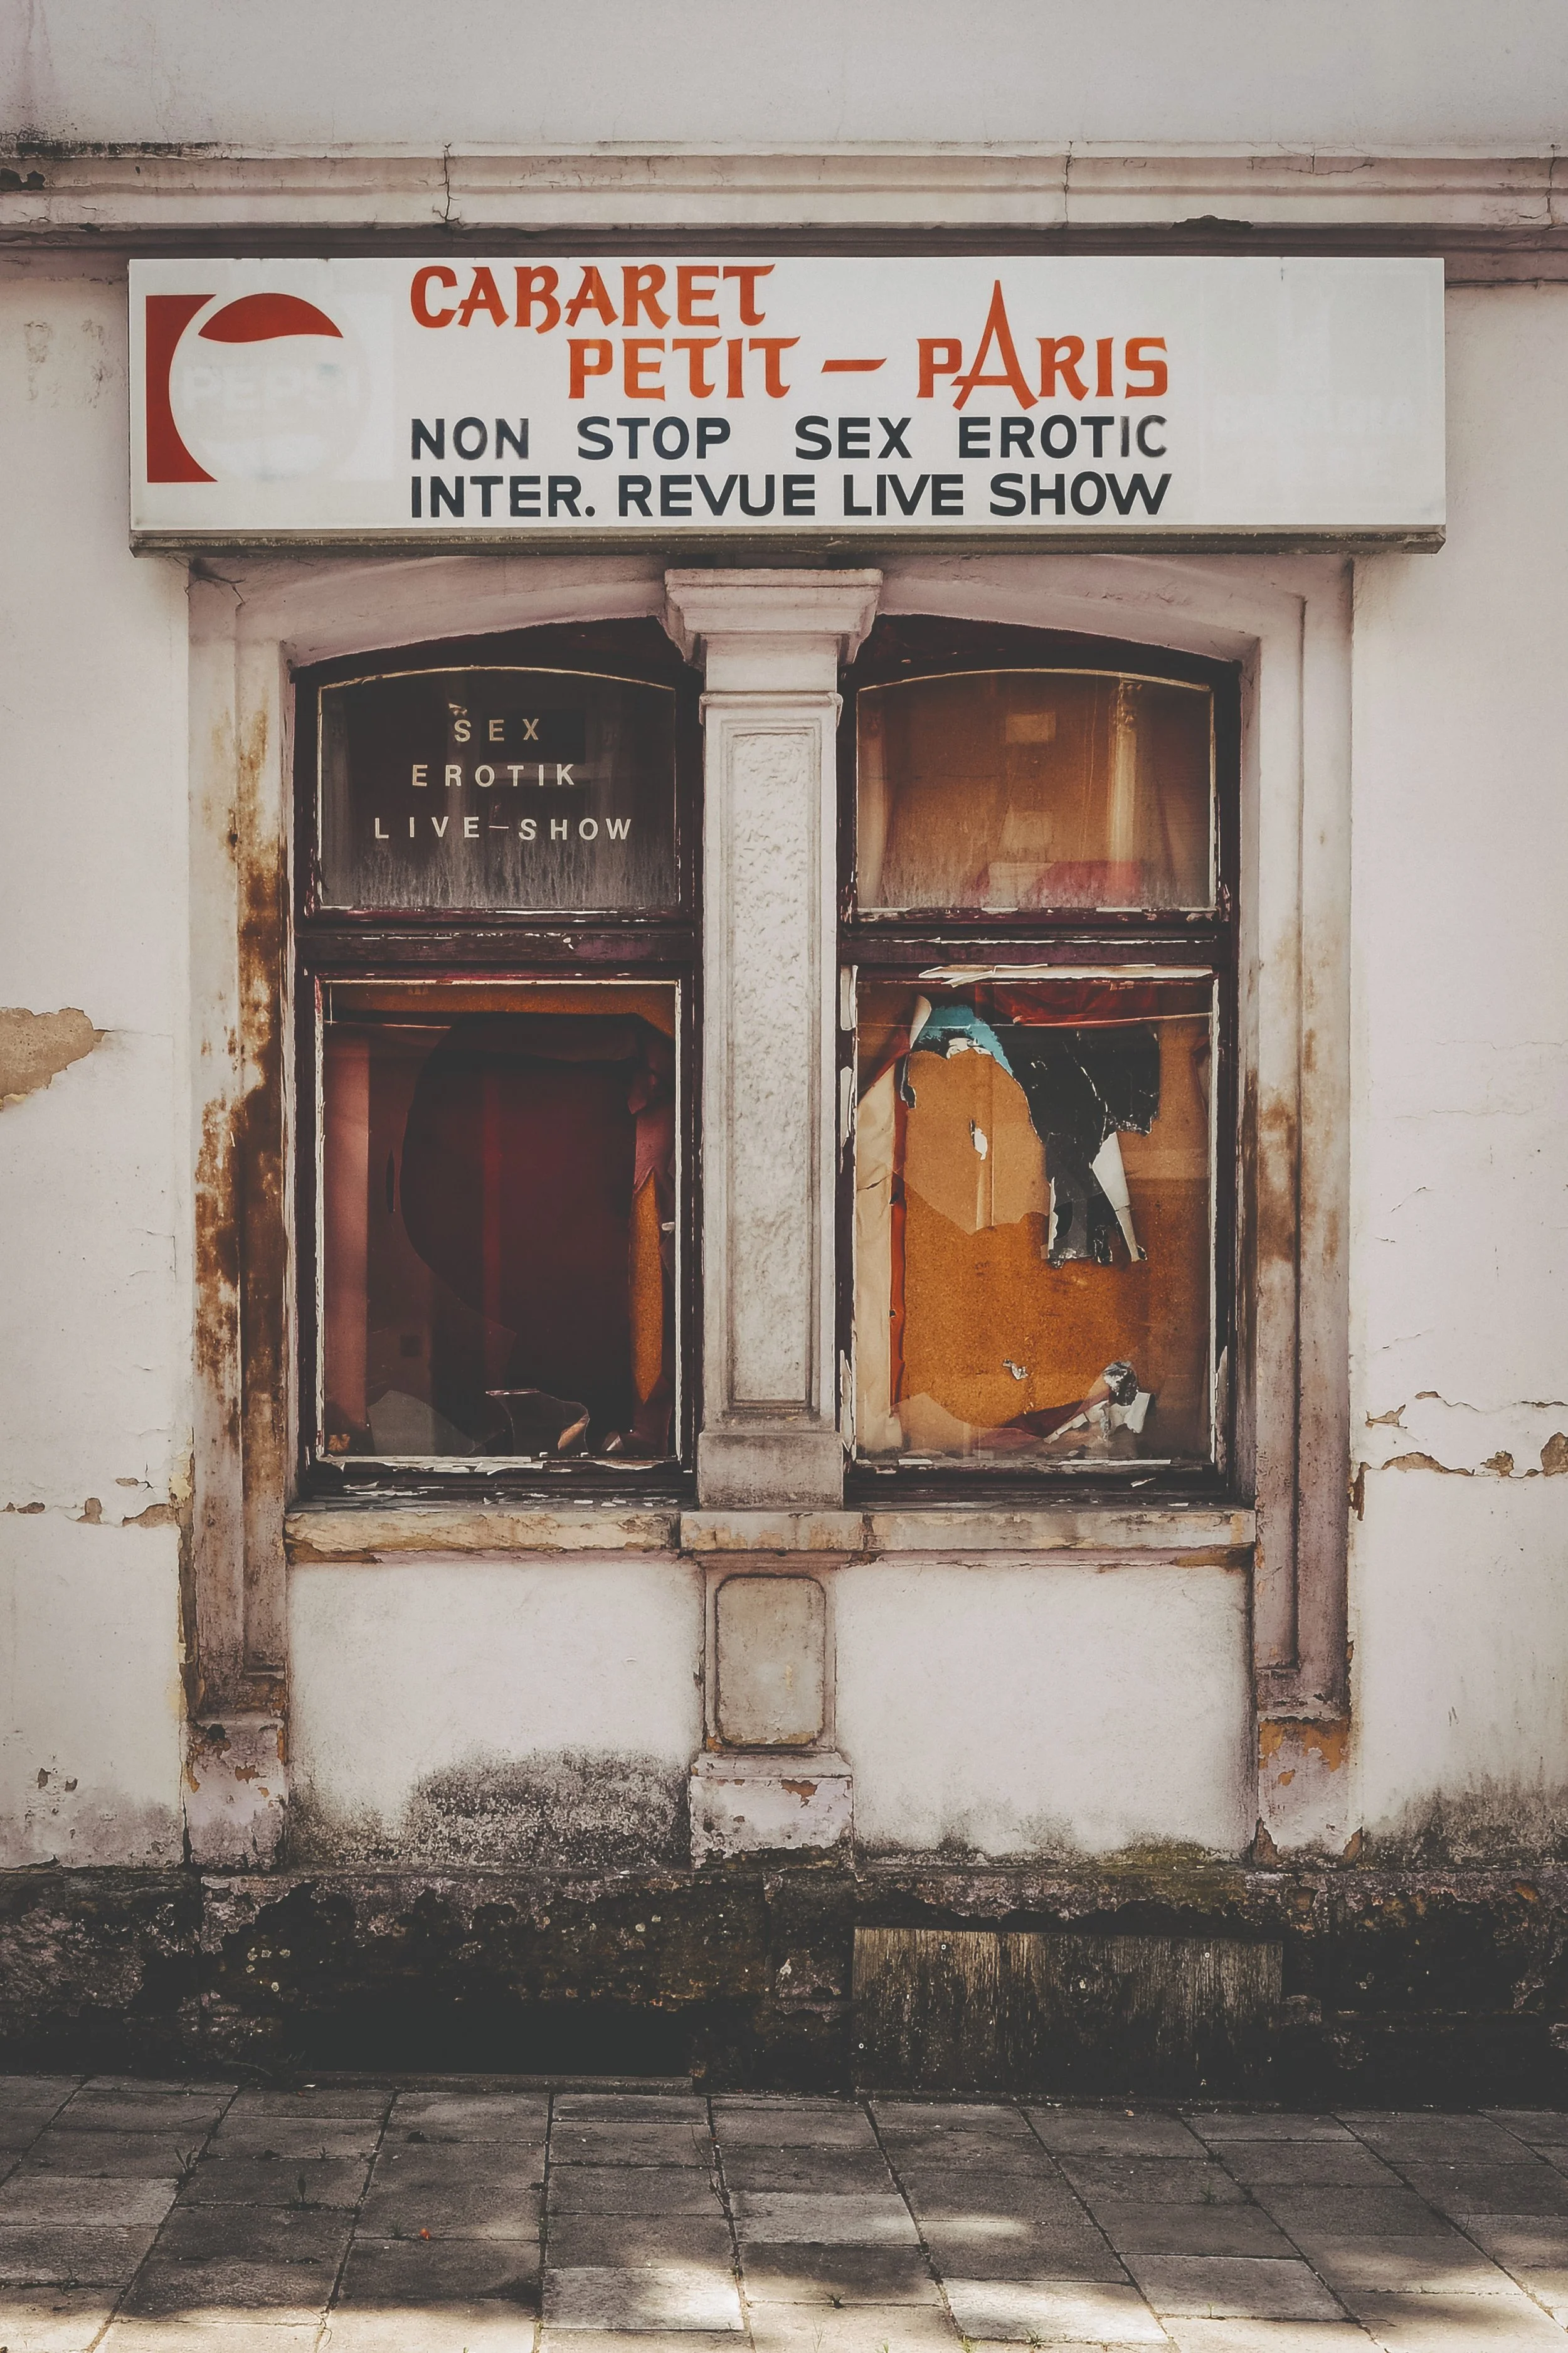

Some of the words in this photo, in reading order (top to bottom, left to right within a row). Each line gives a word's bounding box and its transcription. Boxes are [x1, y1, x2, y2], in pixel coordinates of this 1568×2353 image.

[410, 263, 775, 334] CABARET
[566, 335, 801, 401] PETIT
[916, 279, 1169, 411] PARIS
[410, 416, 529, 461] NON
[576, 415, 731, 461] STOP
[794, 415, 913, 461] SEX
[958, 413, 1168, 460] EROTIC
[410, 474, 596, 518] INTER.
[618, 474, 816, 518] REVUE
[842, 473, 965, 517] LIVE
[989, 470, 1173, 517] SHOW
[453, 718, 540, 743] SEX
[411, 763, 575, 788] EROTIK
